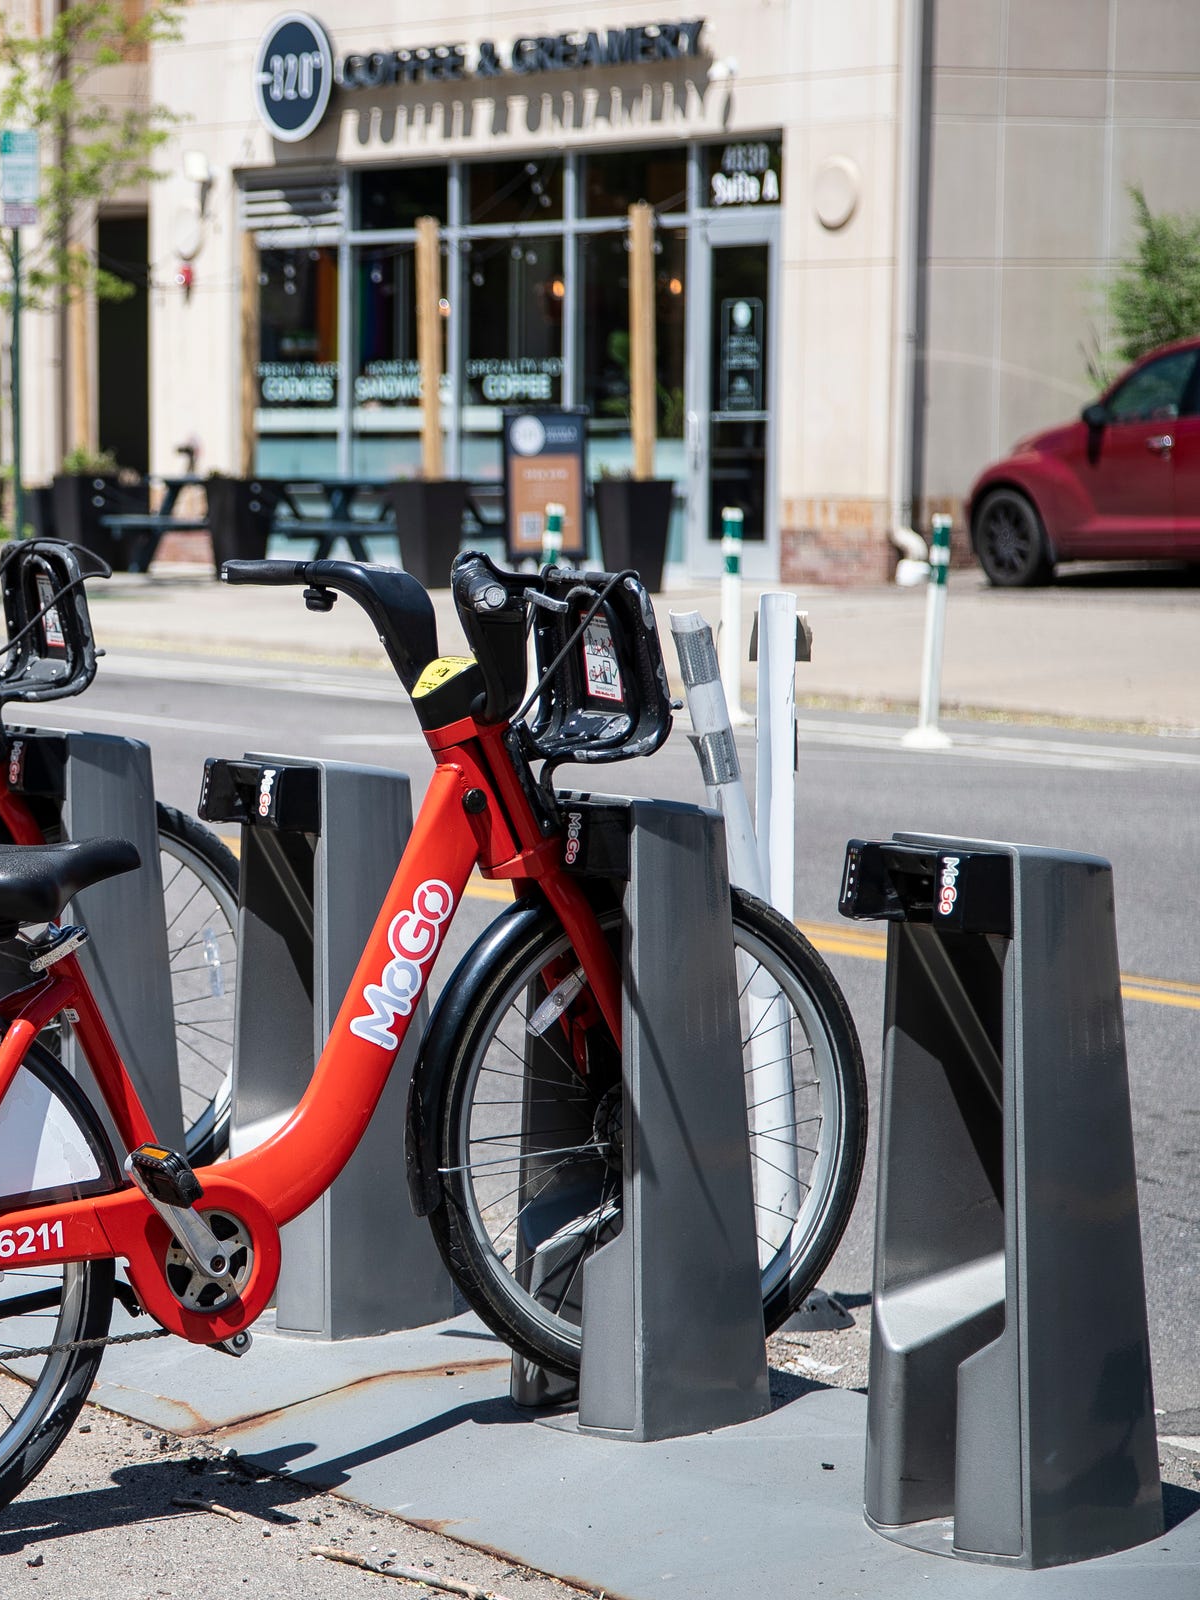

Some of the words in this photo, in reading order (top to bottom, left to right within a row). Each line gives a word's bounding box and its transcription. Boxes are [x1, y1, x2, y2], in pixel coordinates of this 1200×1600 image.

[341, 43, 466, 89] COFFEE
[476, 42, 503, 77] &
[511, 18, 704, 76] CREAMERY
[762, 169, 779, 201] A
[482, 373, 552, 400] COFFEE
[565, 812, 582, 865] MoGo
[940, 856, 960, 915] MoGo
[350, 879, 454, 1051] MoGo
